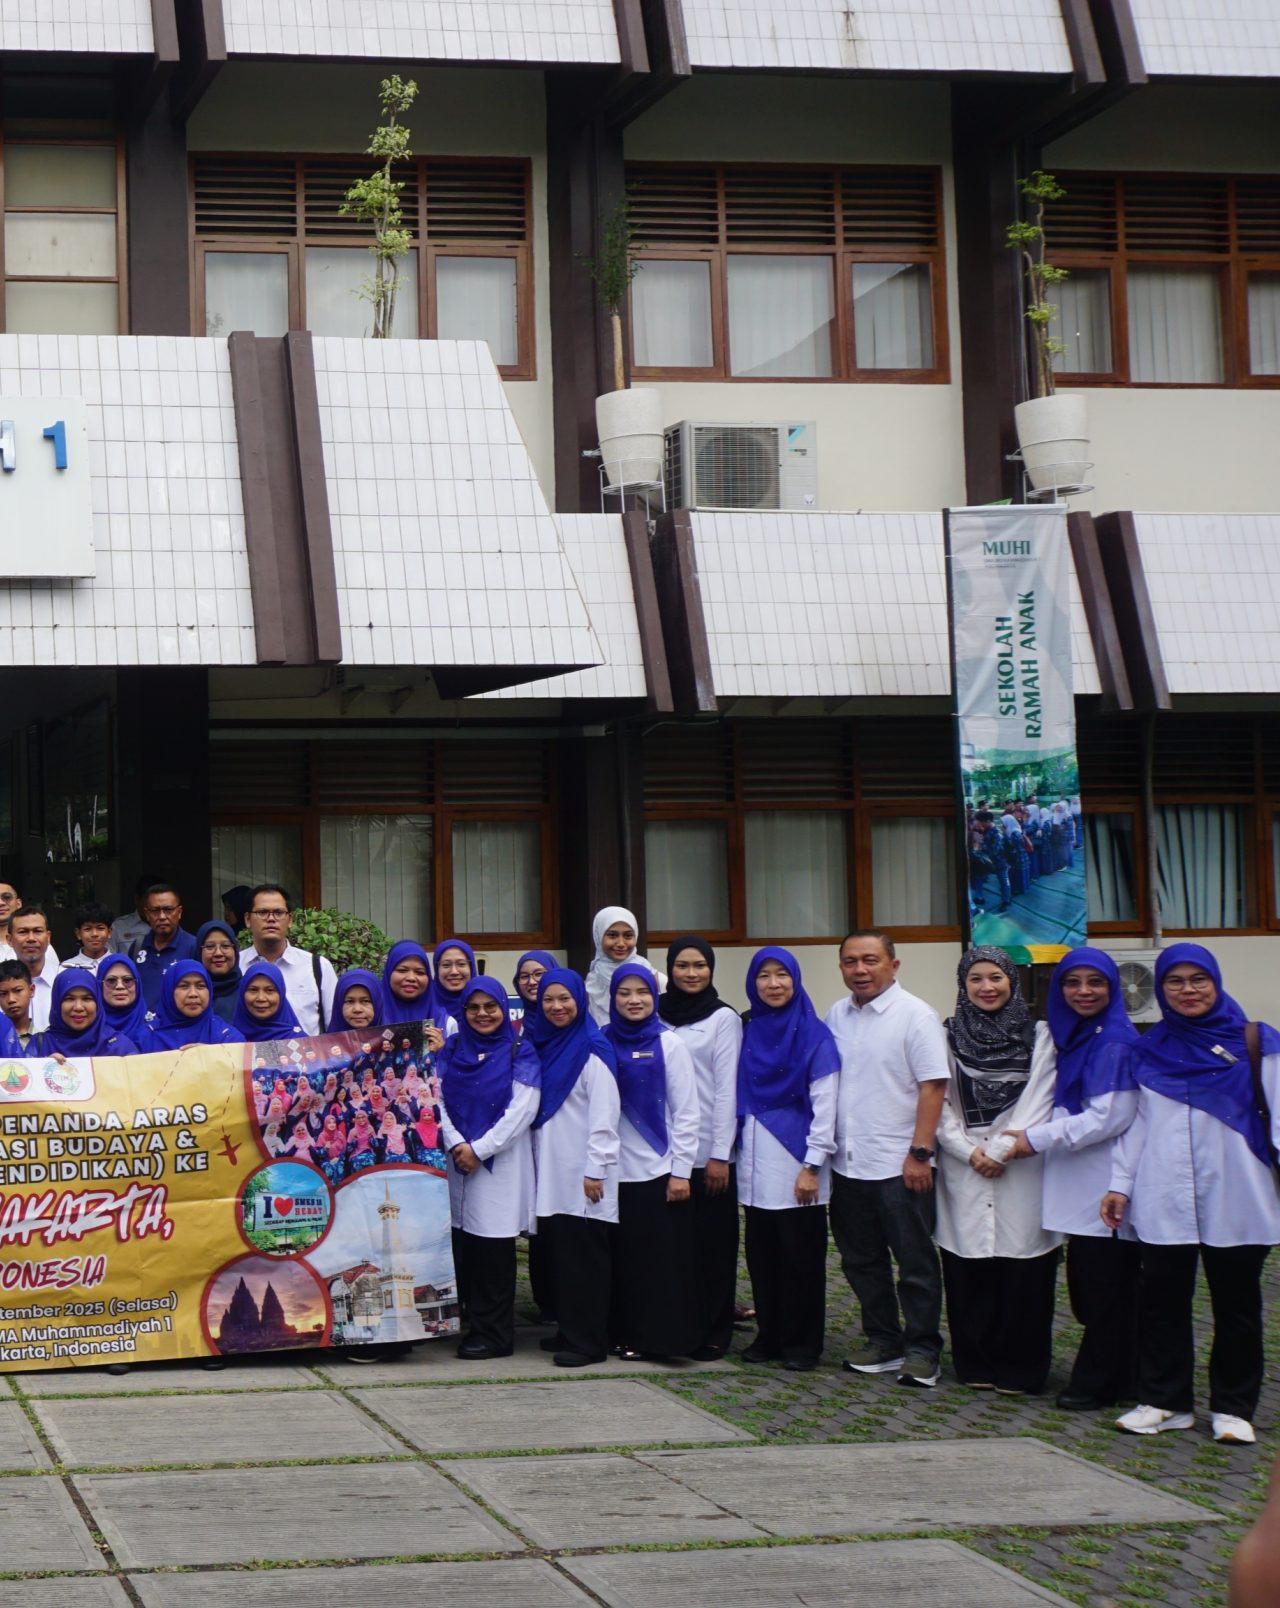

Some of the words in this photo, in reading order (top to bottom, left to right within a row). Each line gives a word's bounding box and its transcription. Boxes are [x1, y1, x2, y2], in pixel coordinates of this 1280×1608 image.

[42, 419, 68, 471] 1
[983, 541, 1031, 556] MUHI
[1019, 590, 1035, 650] ANAK
[995, 616, 1017, 716] SEKOLAH
[1021, 659, 1041, 738] RAMAH
[132, 1103, 208, 1128] ARAS
[42, 1131, 168, 1158] BUDAYA
[174, 1130, 197, 1150] &
[173, 1151, 209, 1174] KE
[264, 1196, 272, 1218] I
[63, 1301, 105, 1317] 2025
[108, 1291, 178, 1317] (Selasa)
[21, 1317, 161, 1342] Muhammadiyah
[163, 1316, 172, 1332] 1
[53, 1337, 136, 1357] Indonesia
